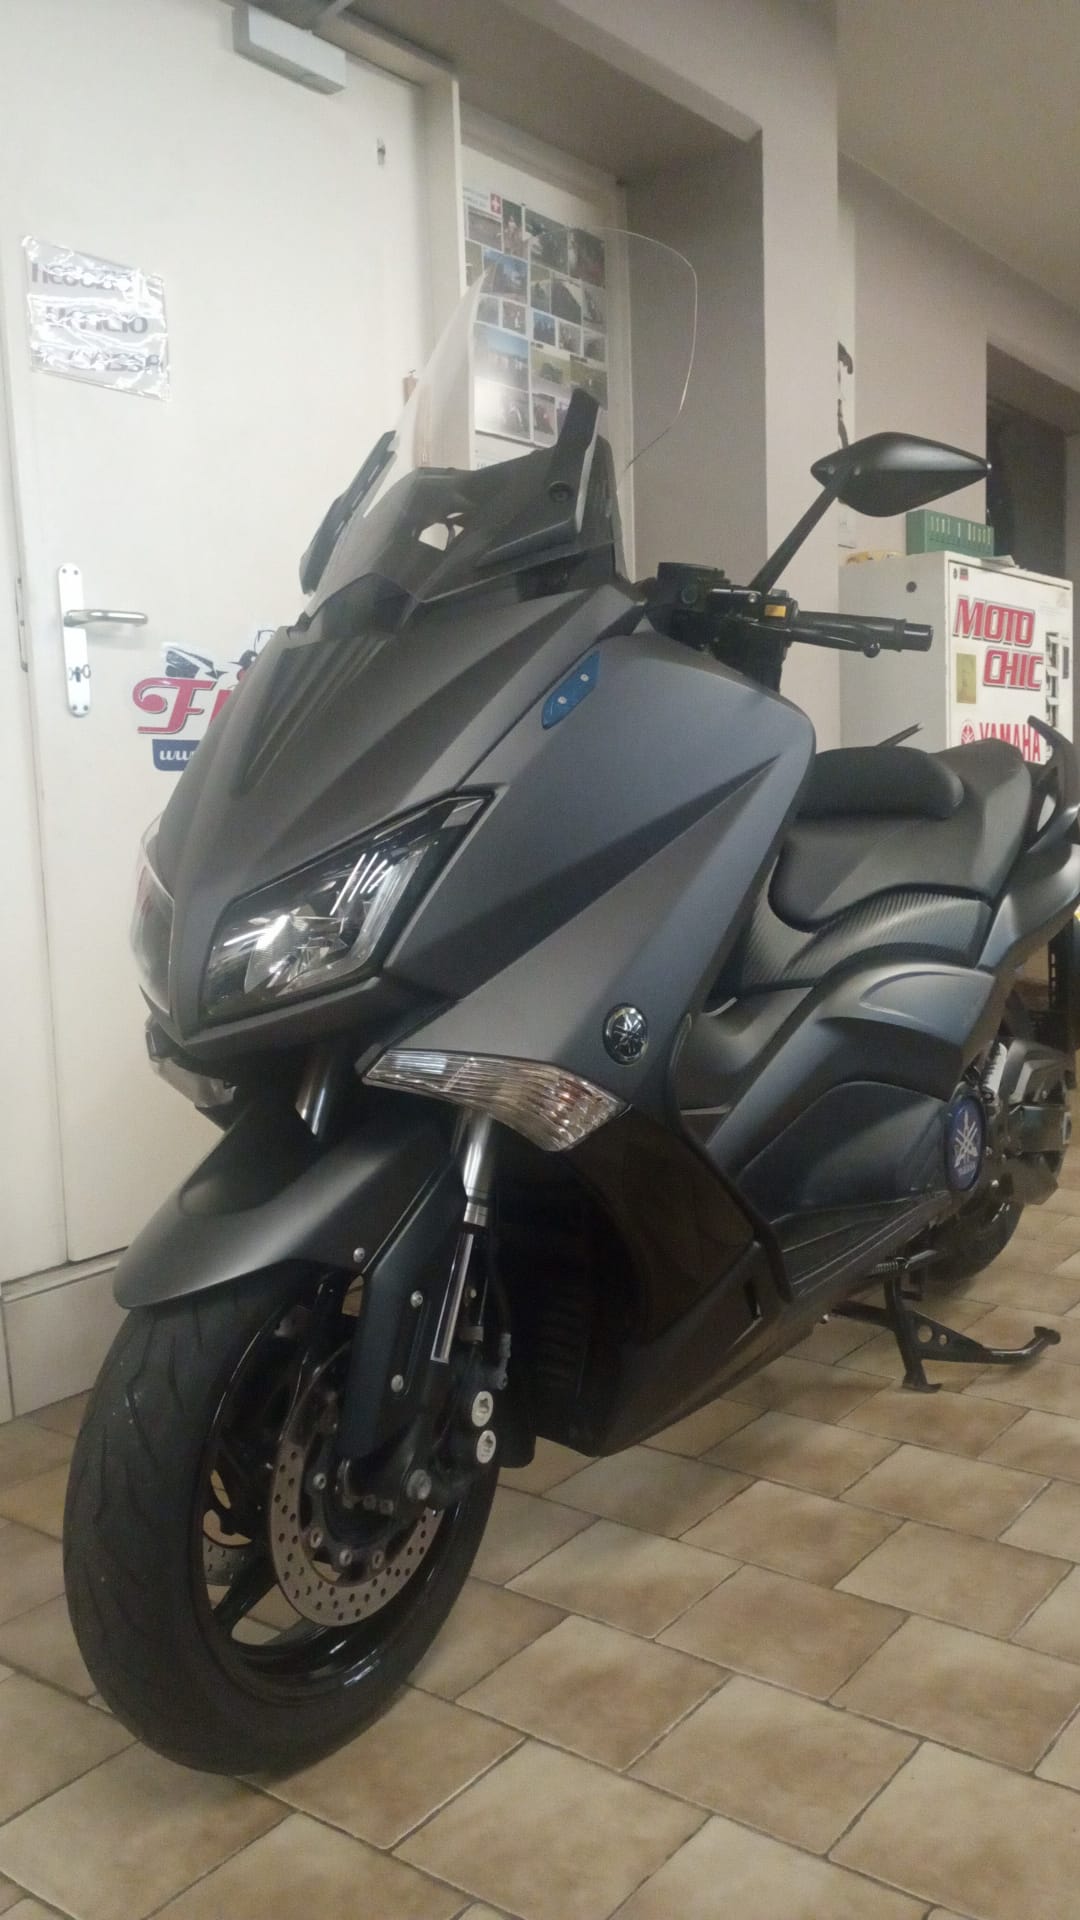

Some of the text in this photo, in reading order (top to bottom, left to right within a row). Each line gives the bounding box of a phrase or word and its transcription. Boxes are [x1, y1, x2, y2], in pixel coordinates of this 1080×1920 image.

[953, 595, 1035, 648] MOTO
[983, 646, 1044, 691] CHIC
[132, 677, 232, 734] F
